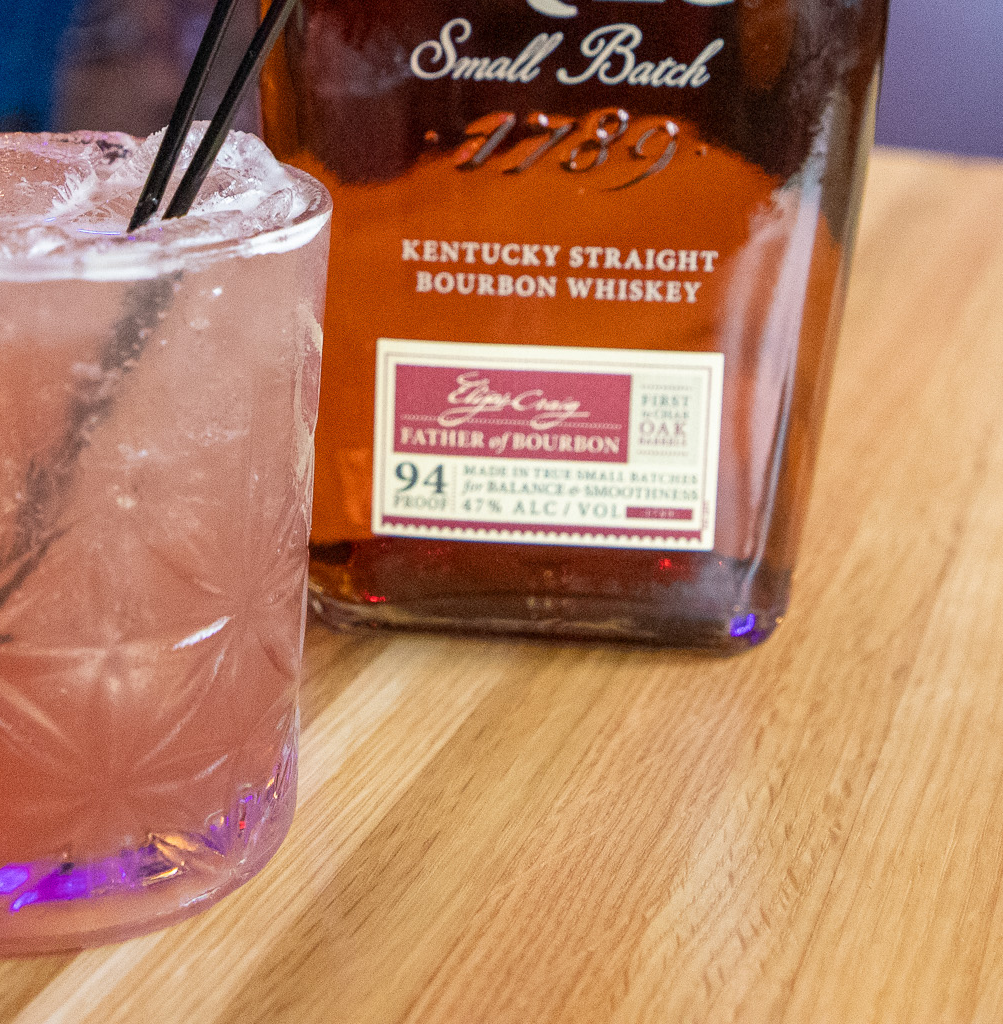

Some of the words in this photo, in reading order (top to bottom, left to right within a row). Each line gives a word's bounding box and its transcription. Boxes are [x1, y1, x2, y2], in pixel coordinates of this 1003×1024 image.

[410, 18, 564, 83] Small
[557, 23, 725, 88] Batch
[456, 107, 679, 193] 1789
[401, 238, 561, 268] KENTUCKY
[569, 245, 719, 273] STRAIGHT
[416, 271, 558, 297] BOURBON
[567, 276, 702, 304] WHISKEY
[641, 393, 693, 407] FIRST
[638, 420, 687, 437] OAK
[400, 427, 485, 449] FATHER
[488, 431, 512, 455] of
[512, 432, 620, 455] BOURBON
[395, 461, 447, 495] 94
[463, 464, 506, 477] MADE
[512, 466, 529, 478] IN
[533, 467, 571, 480] TRUE
[577, 469, 625, 482] SMALL
[630, 472, 699, 485] BATCHES
[394, 494, 447, 510] PROOF
[462, 481, 484, 496] for
[487, 481, 564, 496] BALANCE
[584, 487, 699, 502] SMOOTHNESS
[462, 498, 503, 514] 47%
